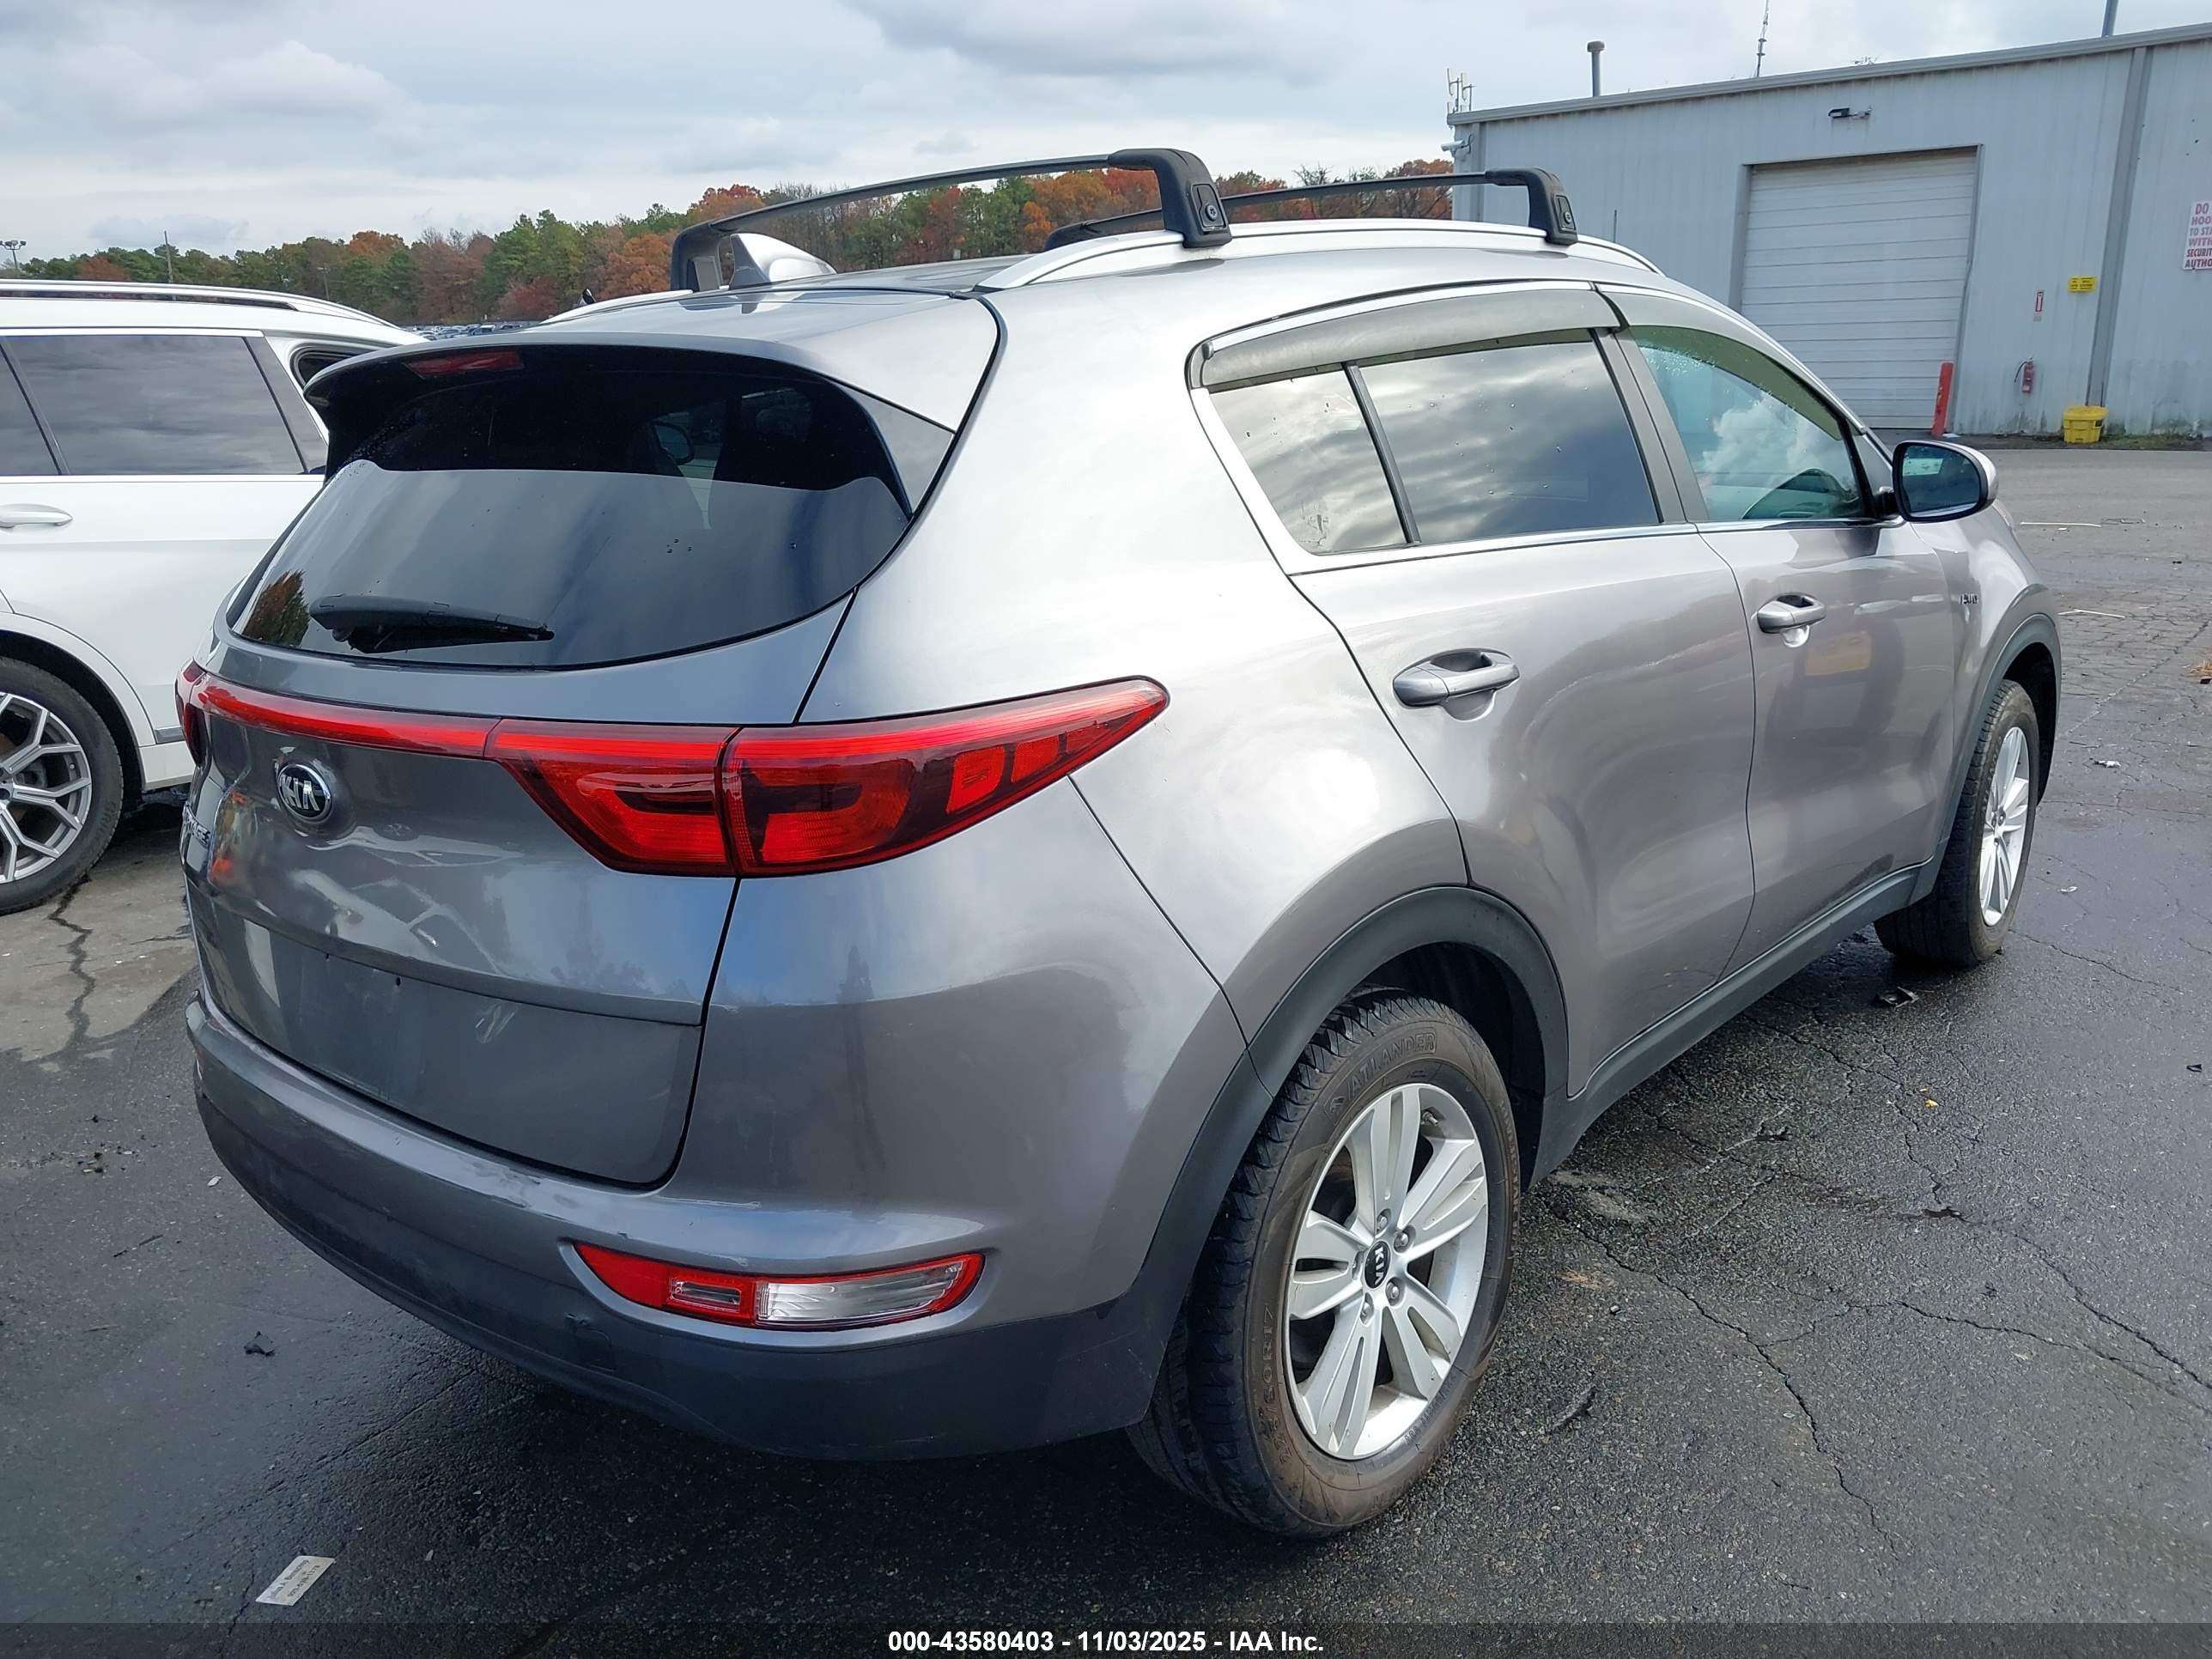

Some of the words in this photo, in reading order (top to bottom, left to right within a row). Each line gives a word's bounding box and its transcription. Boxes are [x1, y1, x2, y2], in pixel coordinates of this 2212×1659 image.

[2195, 203, 2209, 215] DO
[2190, 227, 2198, 236] TO
[279, 773, 320, 811] KIA
